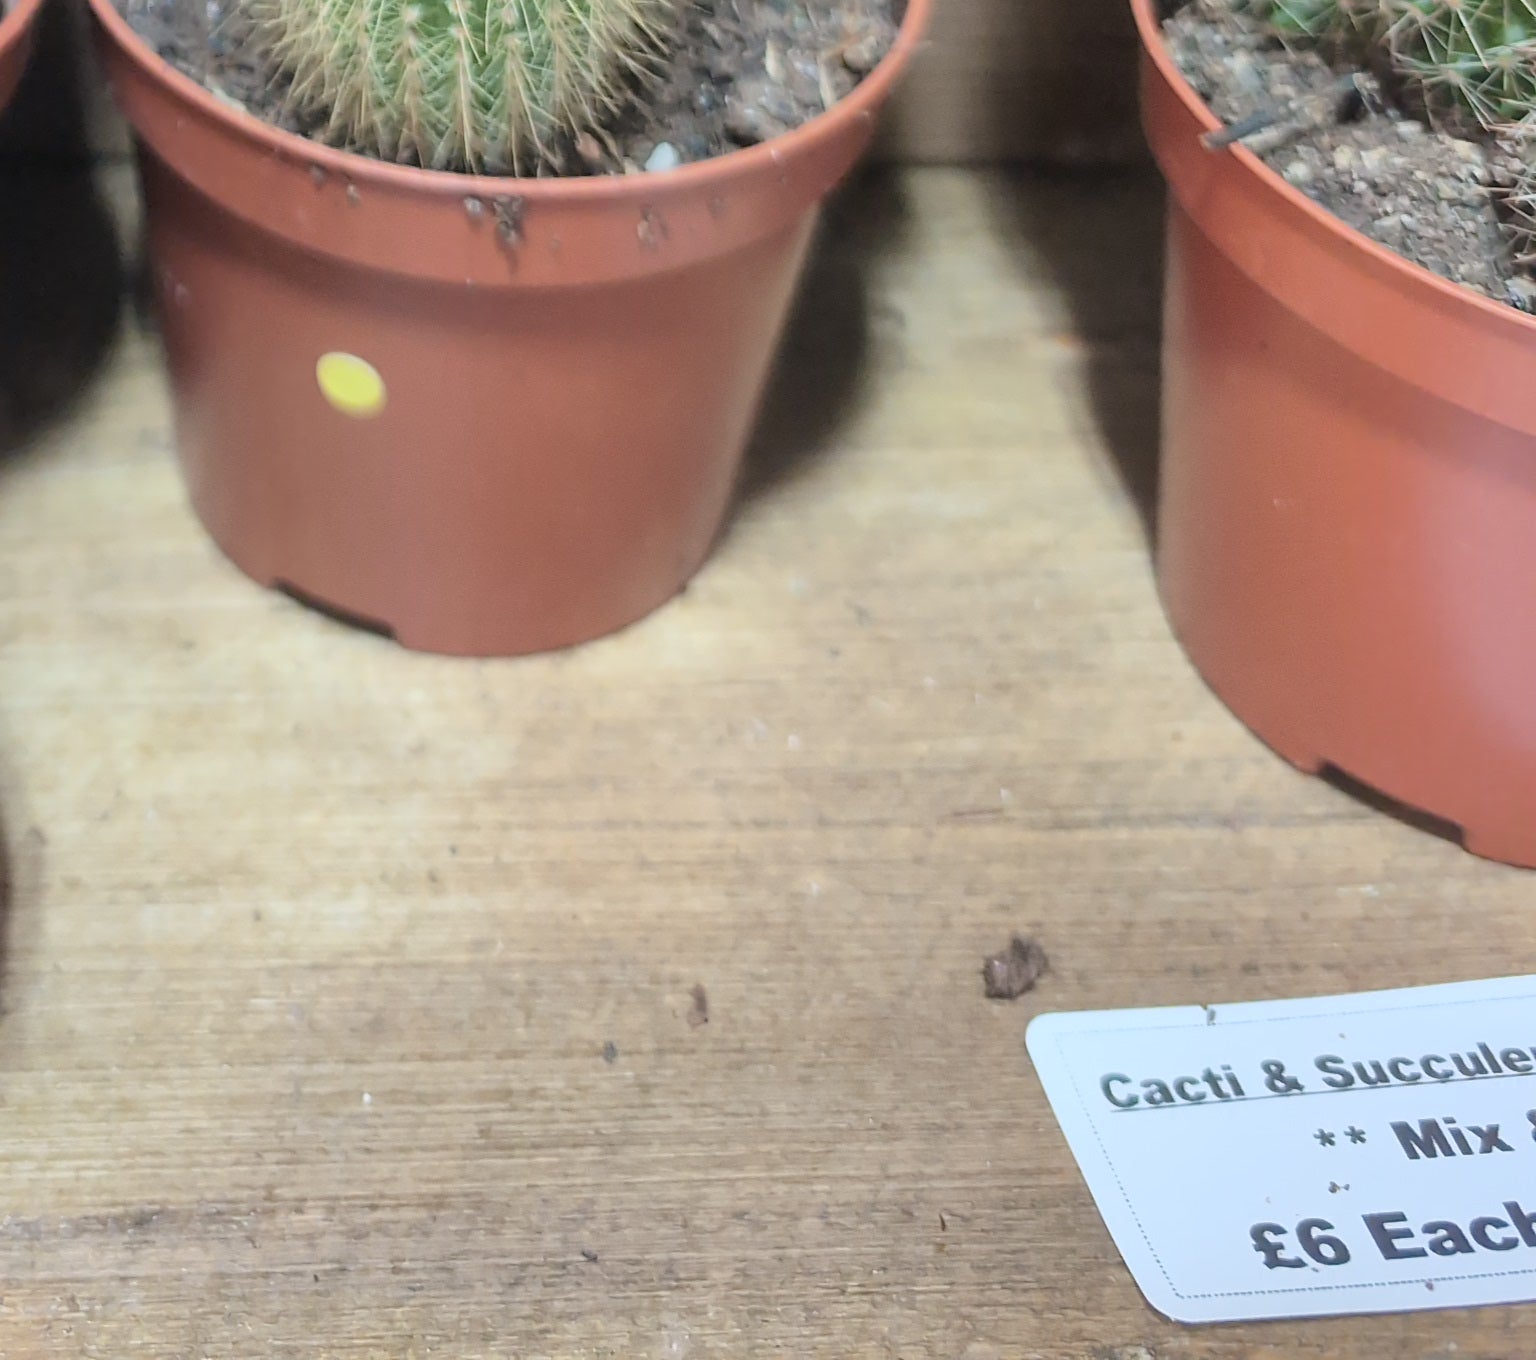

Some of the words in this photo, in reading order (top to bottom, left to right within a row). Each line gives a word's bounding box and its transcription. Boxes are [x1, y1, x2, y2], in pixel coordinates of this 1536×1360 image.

[1100, 1065, 1245, 1109] Cacti
[1260, 1060, 1305, 1094] &
[1314, 1042, 1536, 1089] Succule
[1389, 1116, 1515, 1160] Mix
[1249, 1218, 1351, 1269] £6
